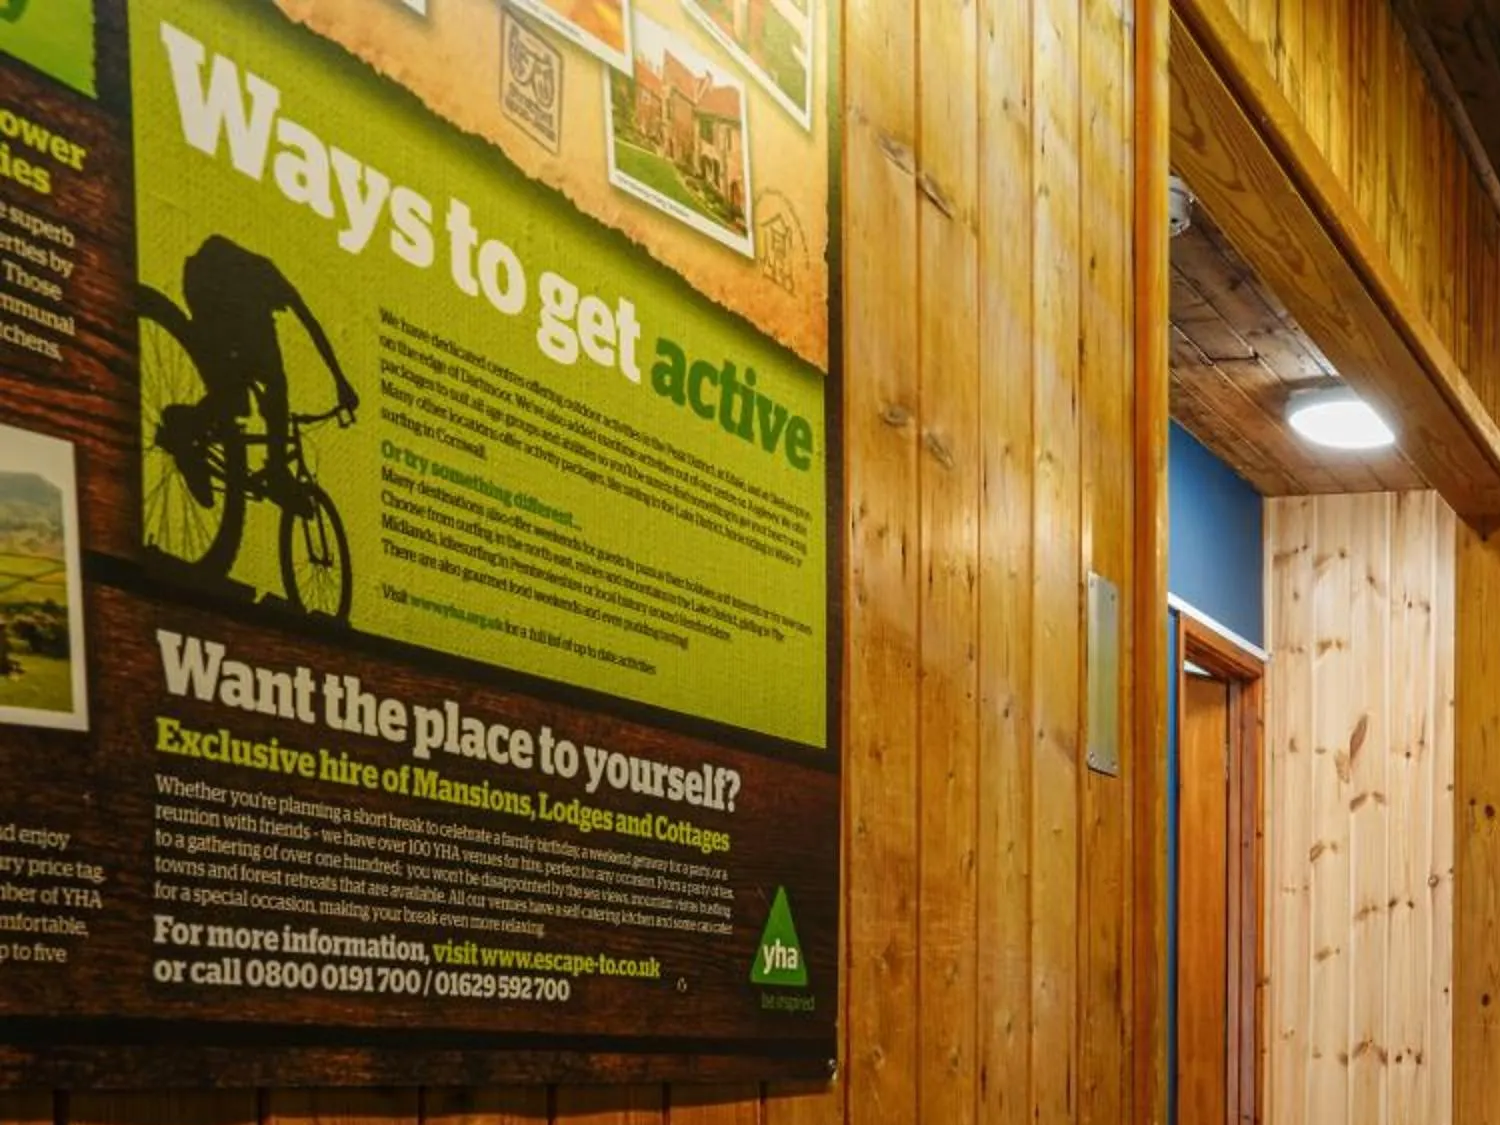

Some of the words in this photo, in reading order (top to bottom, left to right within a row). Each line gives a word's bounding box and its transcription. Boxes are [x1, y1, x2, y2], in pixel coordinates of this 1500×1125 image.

[10, 207, 75, 248] superb
[159, 20, 435, 269] Ways
[446, 197, 526, 315] to
[537, 271, 641, 384] get
[651, 337, 813, 472] active
[2, 258, 63, 302] Those
[51, 249, 74, 279] by
[382, 537, 416, 563] There
[383, 583, 407, 604] Visit
[157, 632, 315, 721] Want
[323, 670, 407, 742] the
[413, 694, 533, 777] place
[539, 725, 579, 780] to
[584, 738, 740, 818] yourself?
[155, 718, 315, 776] Exclusive
[320, 748, 378, 788] hire
[383, 761, 410, 794] of
[413, 768, 535, 818] Mansions,
[538, 792, 613, 835] Lodges
[615, 808, 652, 837] and
[655, 814, 729, 856] Cottages
[155, 774, 226, 802] Whether
[230, 788, 276, 813] you're
[279, 795, 341, 823] planning
[343, 808, 351, 821] a
[353, 807, 387, 826] short
[389, 813, 423, 832] break
[427, 820, 438, 835] to
[439, 822, 493, 843] celebrate
[493, 833, 500, 844] a
[502, 832, 533, 851] family
[18, 827, 71, 850] enjoy
[155, 804, 220, 827] reunion
[223, 812, 256, 832] with
[259, 818, 310, 839] friends
[321, 830, 343, 844] we
[343, 830, 375, 849] have
[377, 838, 405, 853] over
[408, 839, 429, 856] 100
[433, 842, 458, 860] YHA
[462, 850, 502, 866] venues
[504, 854, 518, 869] for
[545, 861, 579, 879] perfect
[27, 857, 74, 877] price
[155, 829, 172, 847] to
[175, 835, 184, 849] a
[187, 834, 260, 861] gathering
[263, 842, 279, 860] of
[280, 848, 312, 864] over
[315, 852, 341, 868] one
[407, 864, 429, 880] you
[465, 870, 480, 885] be
[482, 872, 549, 896] disappointed
[553, 881, 564, 897] by
[155, 855, 204, 877] towns
[207, 861, 238, 880] and
[240, 865, 281, 885] forest
[284, 870, 336, 891] retreats
[339, 876, 364, 894] that
[367, 882, 387, 896] are
[448, 888, 464, 905] All
[467, 894, 484, 907] our
[39, 885, 60, 906] of
[61, 885, 104, 909] YHA
[155, 880, 177, 900] for
[180, 886, 190, 902] a
[194, 884, 247, 909] special
[319, 898, 370, 921] making
[371, 906, 402, 924] your
[403, 906, 439, 925] break
[439, 913, 468, 928] even
[470, 916, 502, 931] more
[12, 942, 32, 962] to
[33, 941, 69, 964] five
[153, 913, 203, 946] For
[207, 923, 279, 950] more
[282, 925, 429, 963] information,
[432, 937, 478, 964] visit
[480, 943, 660, 980] www.escape-to.co.uk
[763, 938, 799, 975] yha
[153, 958, 187, 982] or
[189, 955, 242, 985] call
[245, 958, 318, 988] 0800
[321, 963, 374, 991] 0191
[377, 967, 421, 993] 700
[423, 969, 432, 995] /
[434, 970, 496, 997] 01629
[498, 974, 533, 998] 592
[534, 977, 570, 1000] 700
